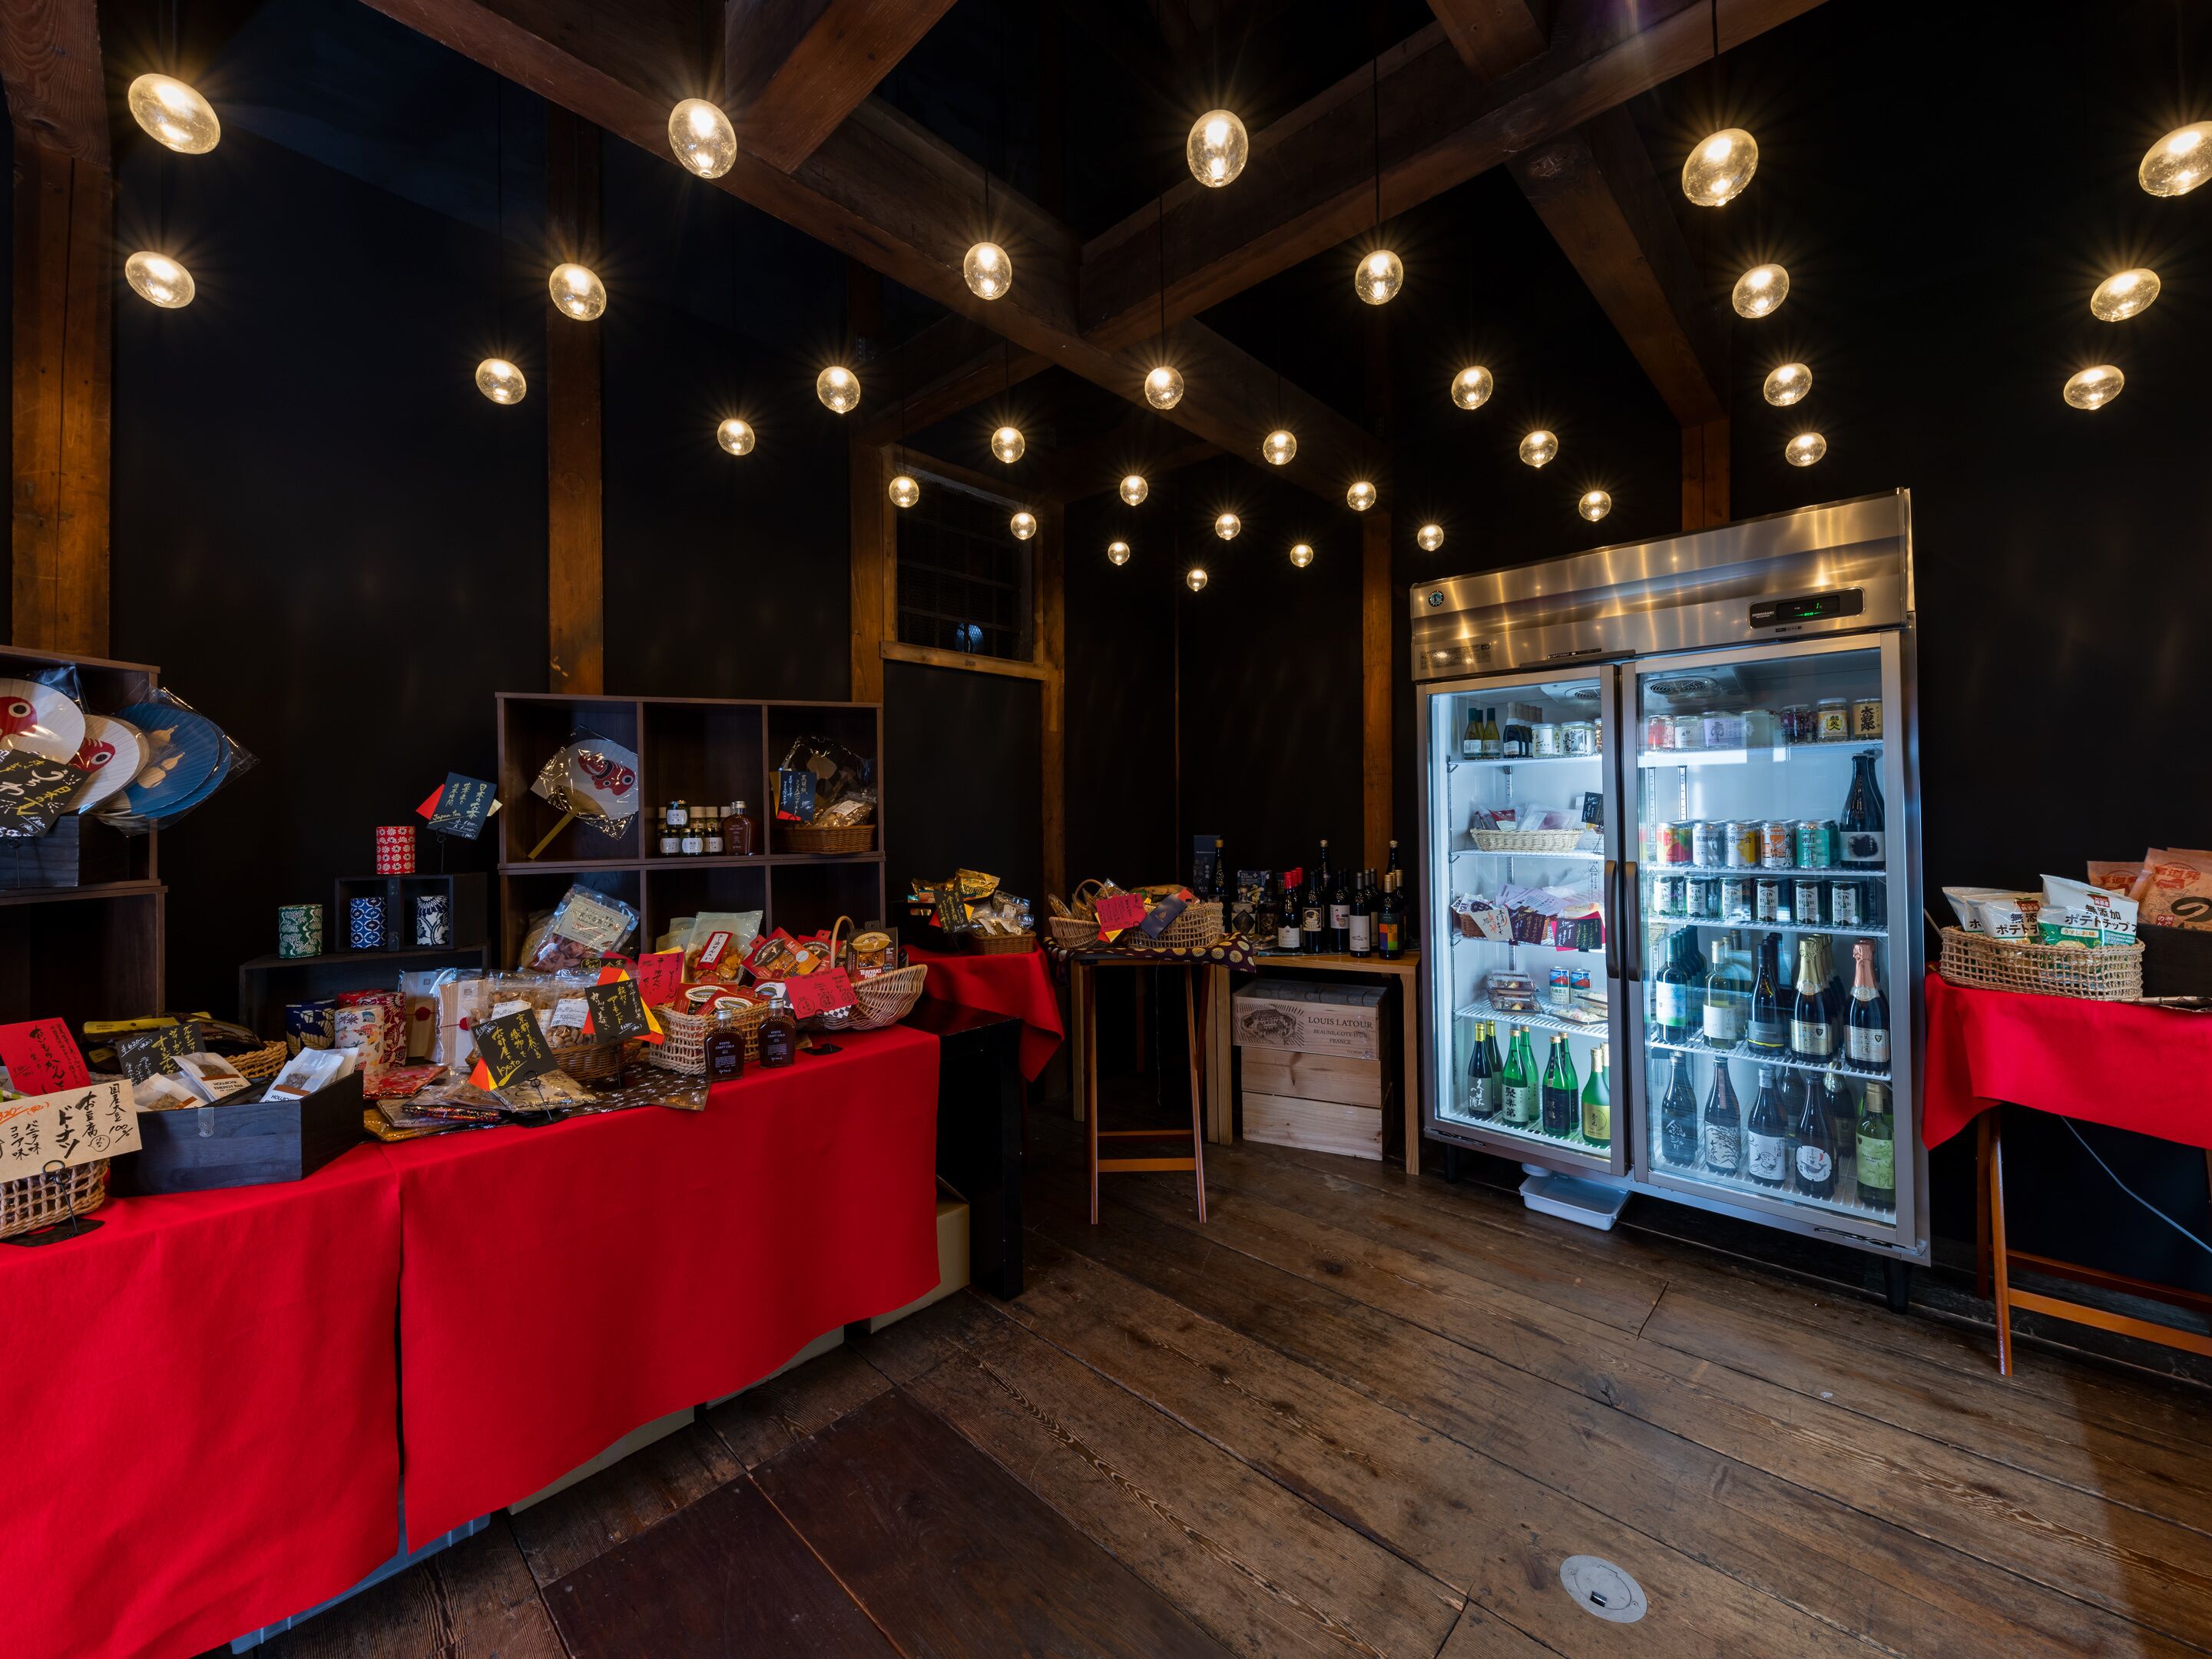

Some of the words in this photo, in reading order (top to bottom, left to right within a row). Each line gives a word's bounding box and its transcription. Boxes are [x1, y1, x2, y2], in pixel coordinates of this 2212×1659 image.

[1802, 833, 1816, 863] 新大地
[2085, 905, 2121, 920] 無添加
[607, 995, 624, 1025] アーモンド
[1308, 1016, 1334, 1025] LOUIS
[1336, 1019, 1373, 1028] LATOUR
[75, 1091, 97, 1137] お豆腐
[106, 1083, 126, 1122] 国産大豆
[1505, 1087, 1516, 1118] 聚楽第
[10, 1126, 30, 1161] ココア味
[25, 1120, 42, 1155] バニラ味
[55, 1105, 80, 1159] ドーナツ
[109, 1124, 134, 1144] 100%
